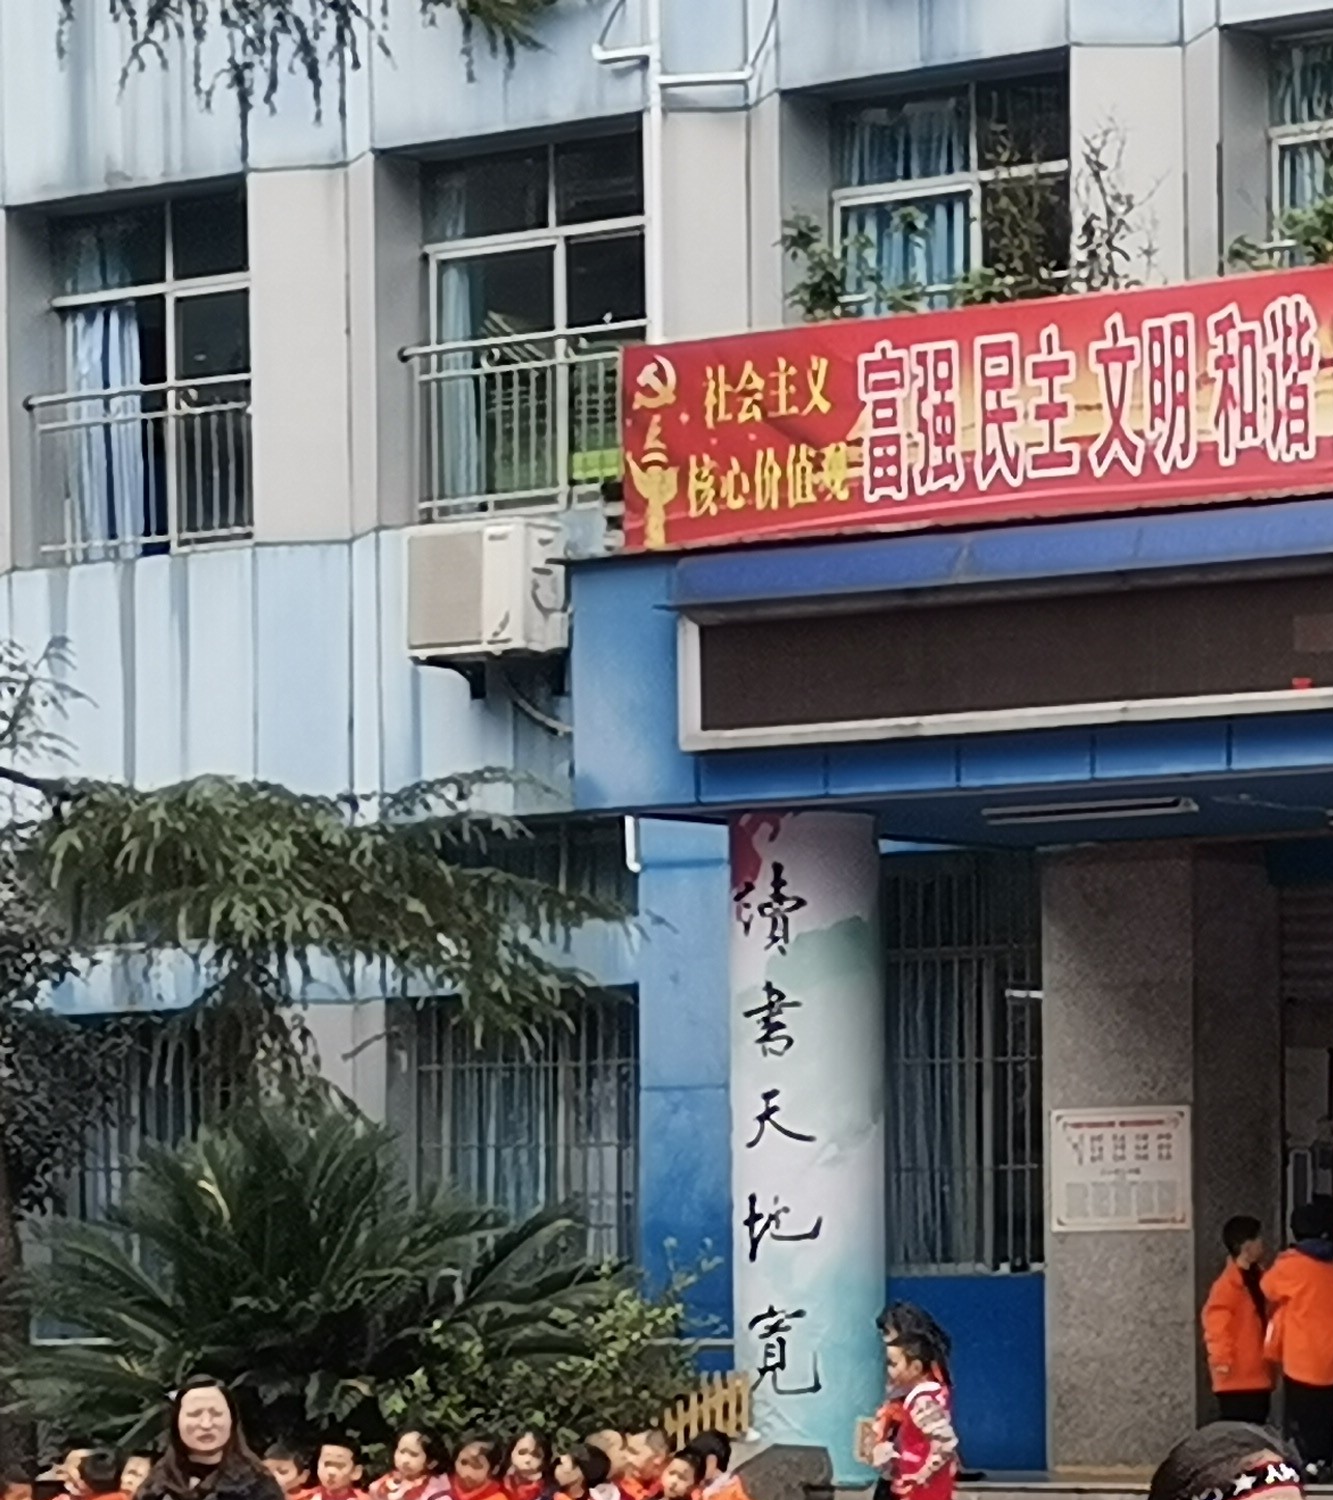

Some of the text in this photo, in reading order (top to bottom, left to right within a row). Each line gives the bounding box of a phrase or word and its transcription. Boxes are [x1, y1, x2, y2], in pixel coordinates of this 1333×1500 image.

[702, 354, 833, 430] 社会主义
[687, 440, 851, 519] 核心价值观
